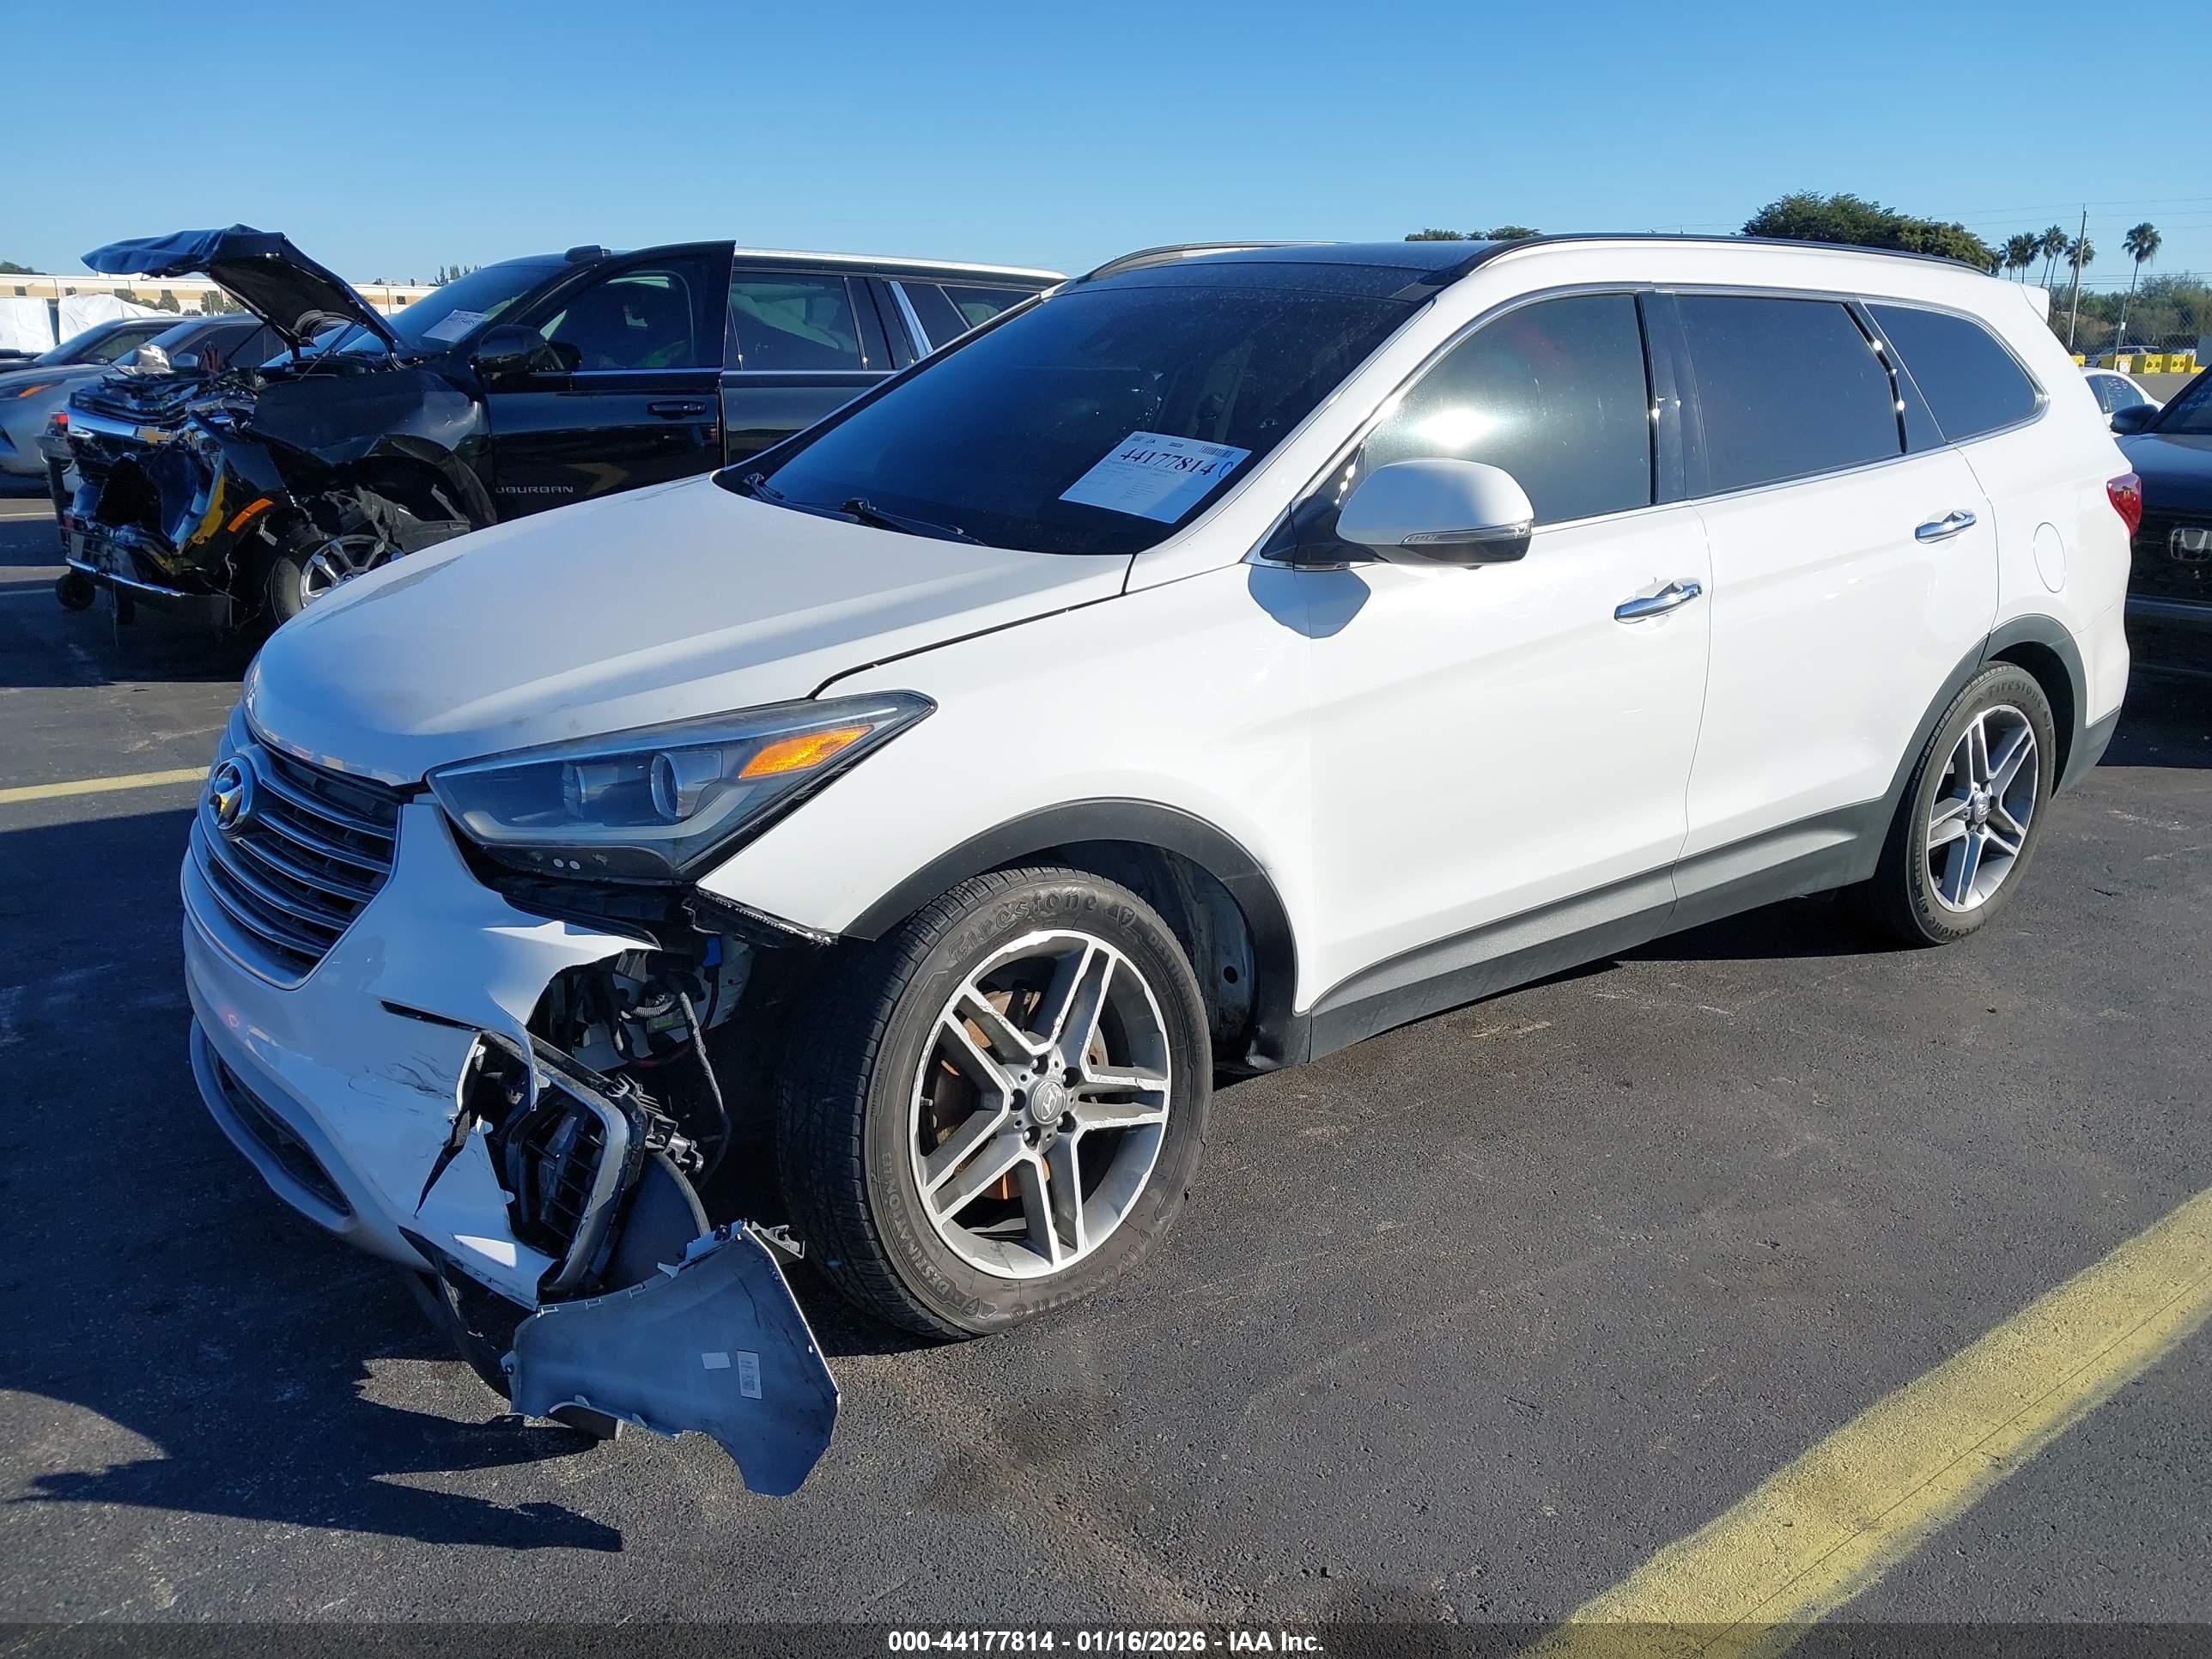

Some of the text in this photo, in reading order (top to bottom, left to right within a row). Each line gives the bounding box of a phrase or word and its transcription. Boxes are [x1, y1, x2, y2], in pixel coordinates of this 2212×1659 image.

[1120, 448, 1218, 476] 44177814
[948, 889, 1097, 963] Firestone
[883, 1176, 951, 1296] DESTINATION
